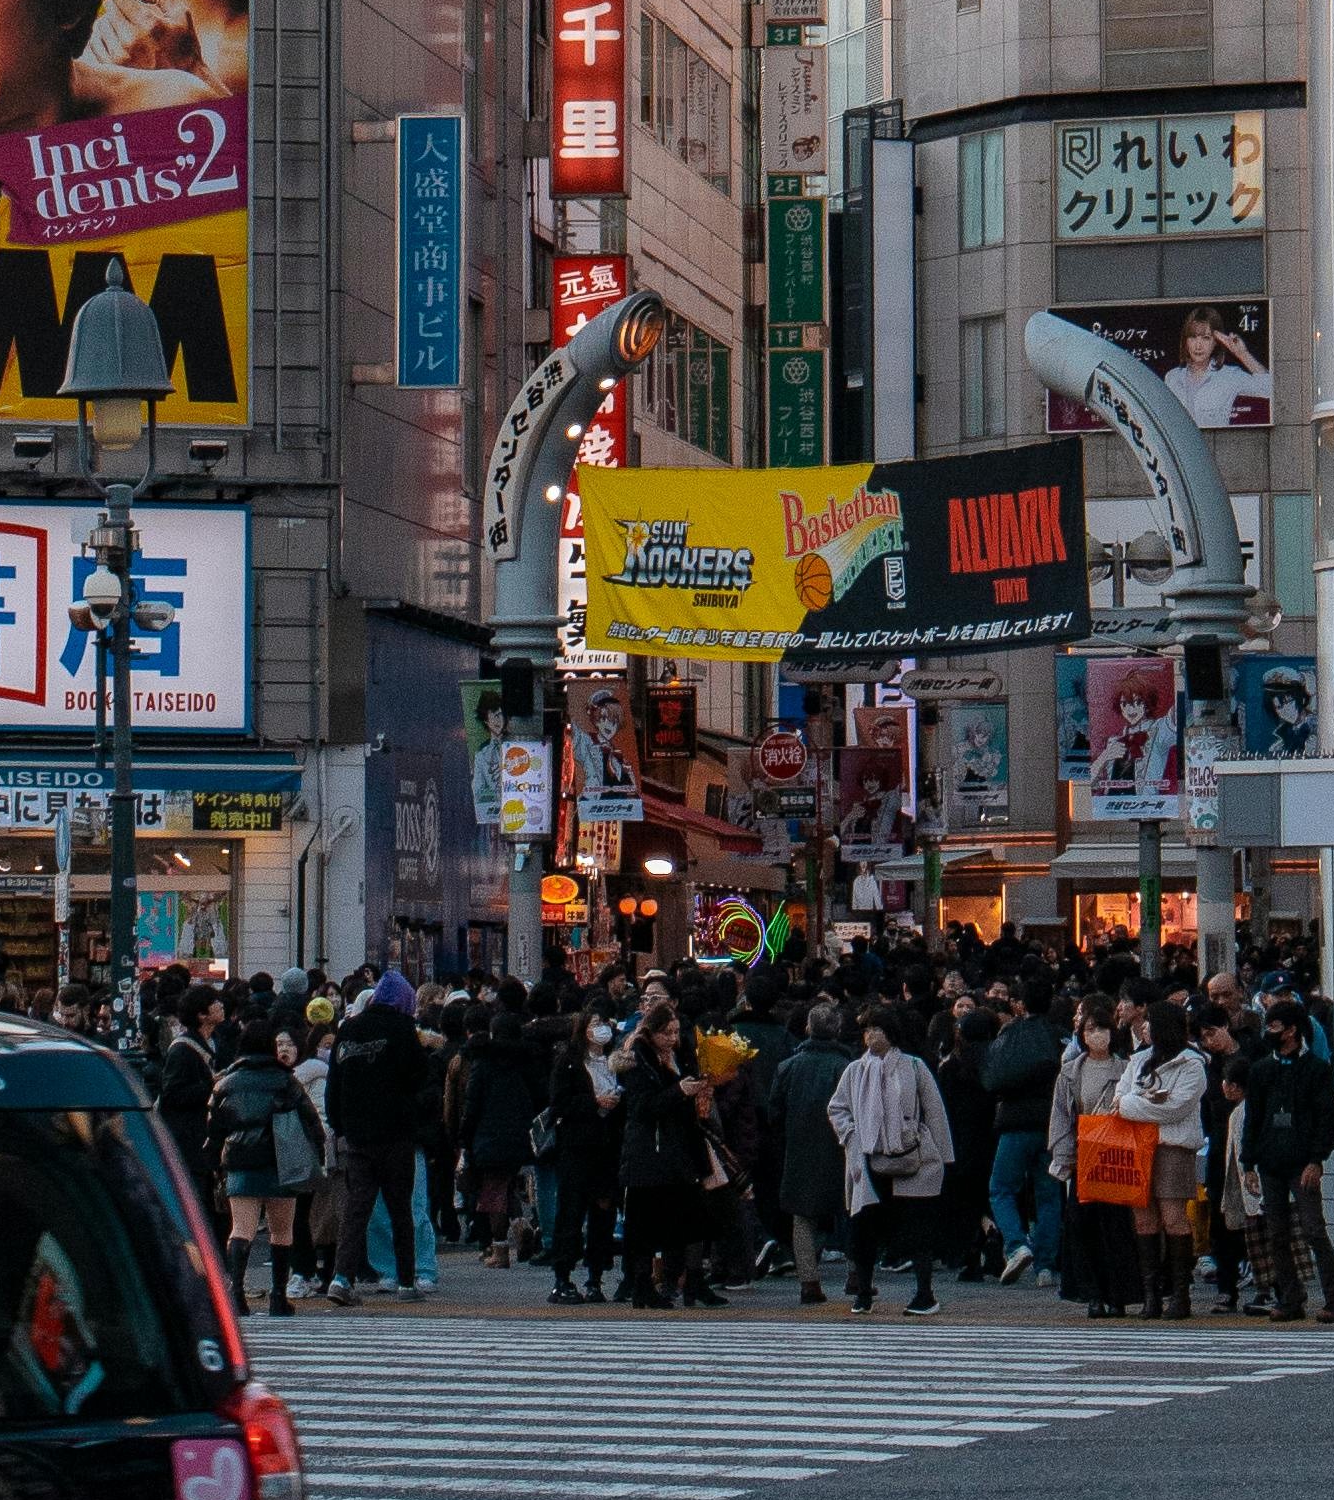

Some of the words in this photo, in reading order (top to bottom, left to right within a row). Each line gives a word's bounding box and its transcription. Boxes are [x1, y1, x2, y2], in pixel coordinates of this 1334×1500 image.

[773, 28, 798, 43] 3F
[30, 122, 125, 183] Inci
[1112, 125, 1262, 174] れいわ
[773, 178, 798, 194] 2F
[1062, 182, 1262, 232] クリニック
[41, 214, 118, 241] インシデンツ
[413, 130, 450, 373] 大盛堂商事ビル
[1238, 314, 1260, 332] 4F
[775, 329, 800, 345] 1F
[490, 354, 564, 550] 渋谷センター街
[650, 520, 689, 547] SUN
[780, 487, 901, 559] Basketball
[948, 485, 1067, 575] ALVARK
[609, 520, 754, 589] ROCKERS
[692, 591, 740, 609] SHIBUYA
[133, 690, 218, 713] TAISEIDO
[764, 747, 803, 767] 消火栓
[193, 792, 282, 807] サイン・特典付
[196, 1337, 225, 1372] 6
